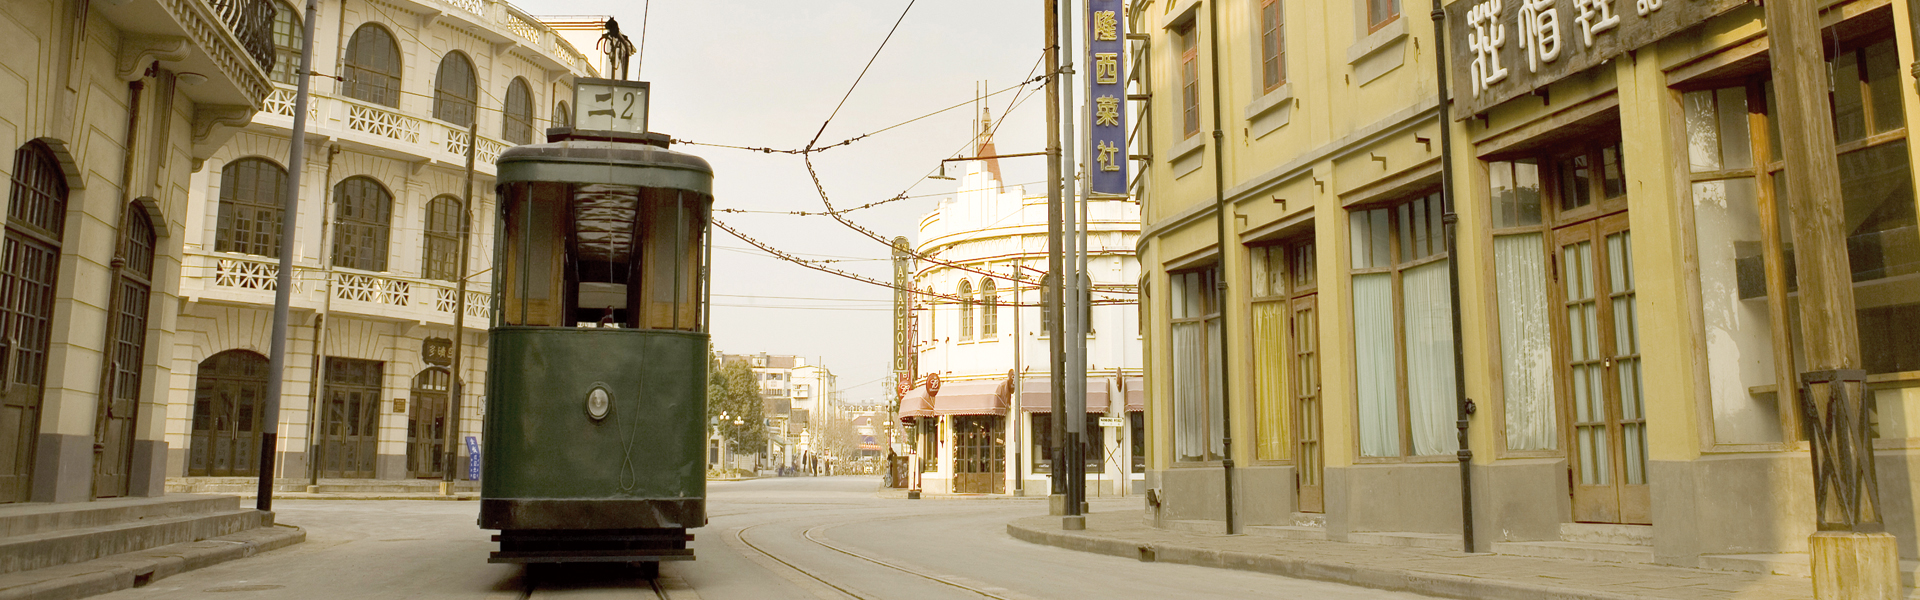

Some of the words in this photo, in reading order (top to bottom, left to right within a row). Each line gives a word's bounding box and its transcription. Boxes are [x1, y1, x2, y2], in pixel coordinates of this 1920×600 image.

[588, 92, 616, 119] 二
[621, 91, 635, 120] 2
[1094, 10, 1120, 172] 隆西菜社
